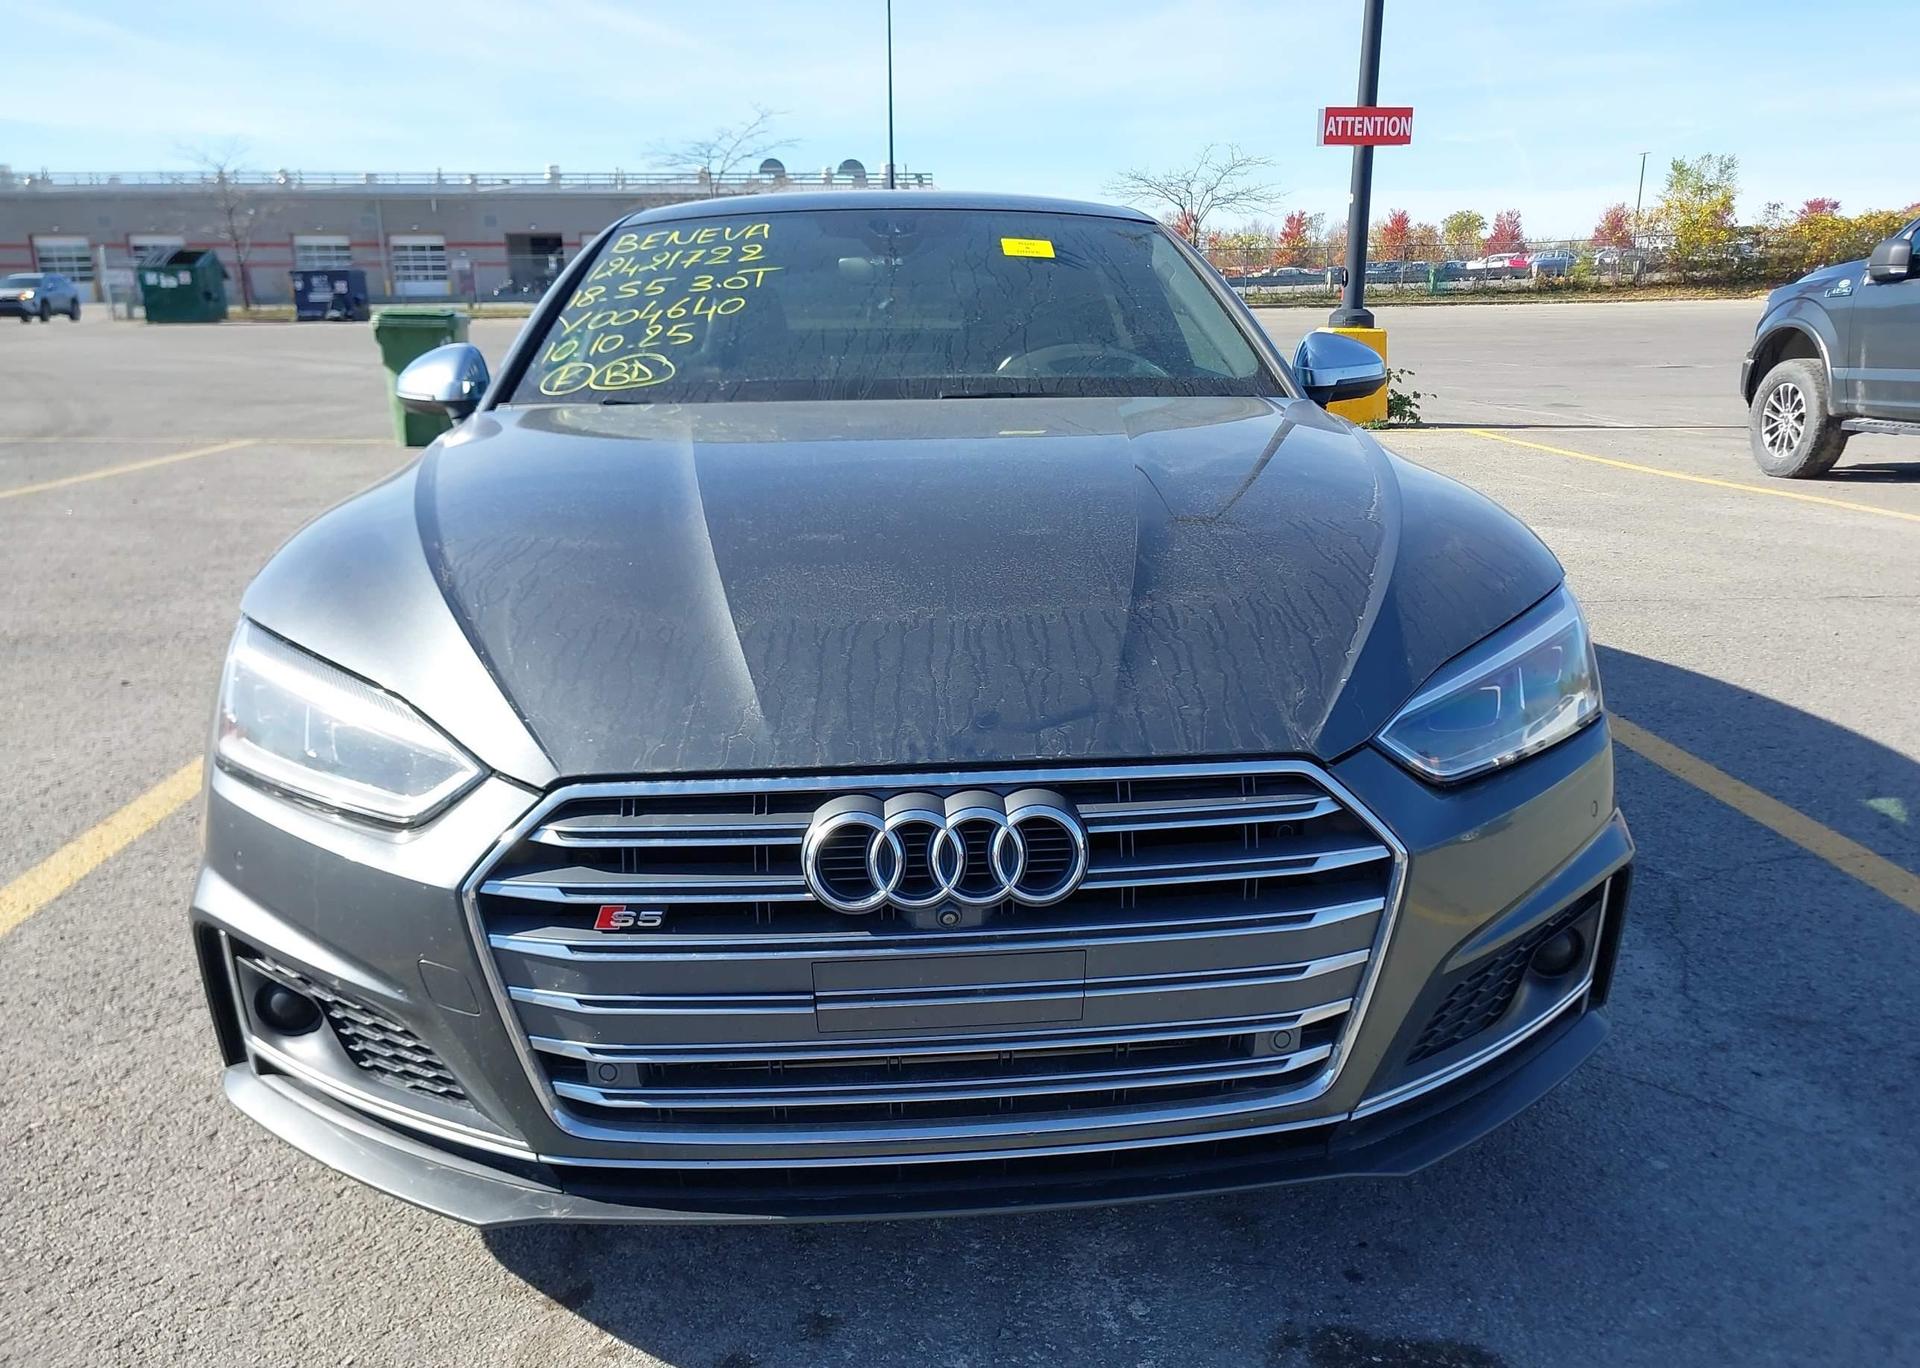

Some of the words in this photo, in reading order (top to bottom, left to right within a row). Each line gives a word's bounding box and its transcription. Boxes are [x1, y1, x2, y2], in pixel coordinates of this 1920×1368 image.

[1325, 116, 1412, 137] ATTENTION
[610, 223, 771, 254] BENEVA
[609, 911, 663, 927] S5
